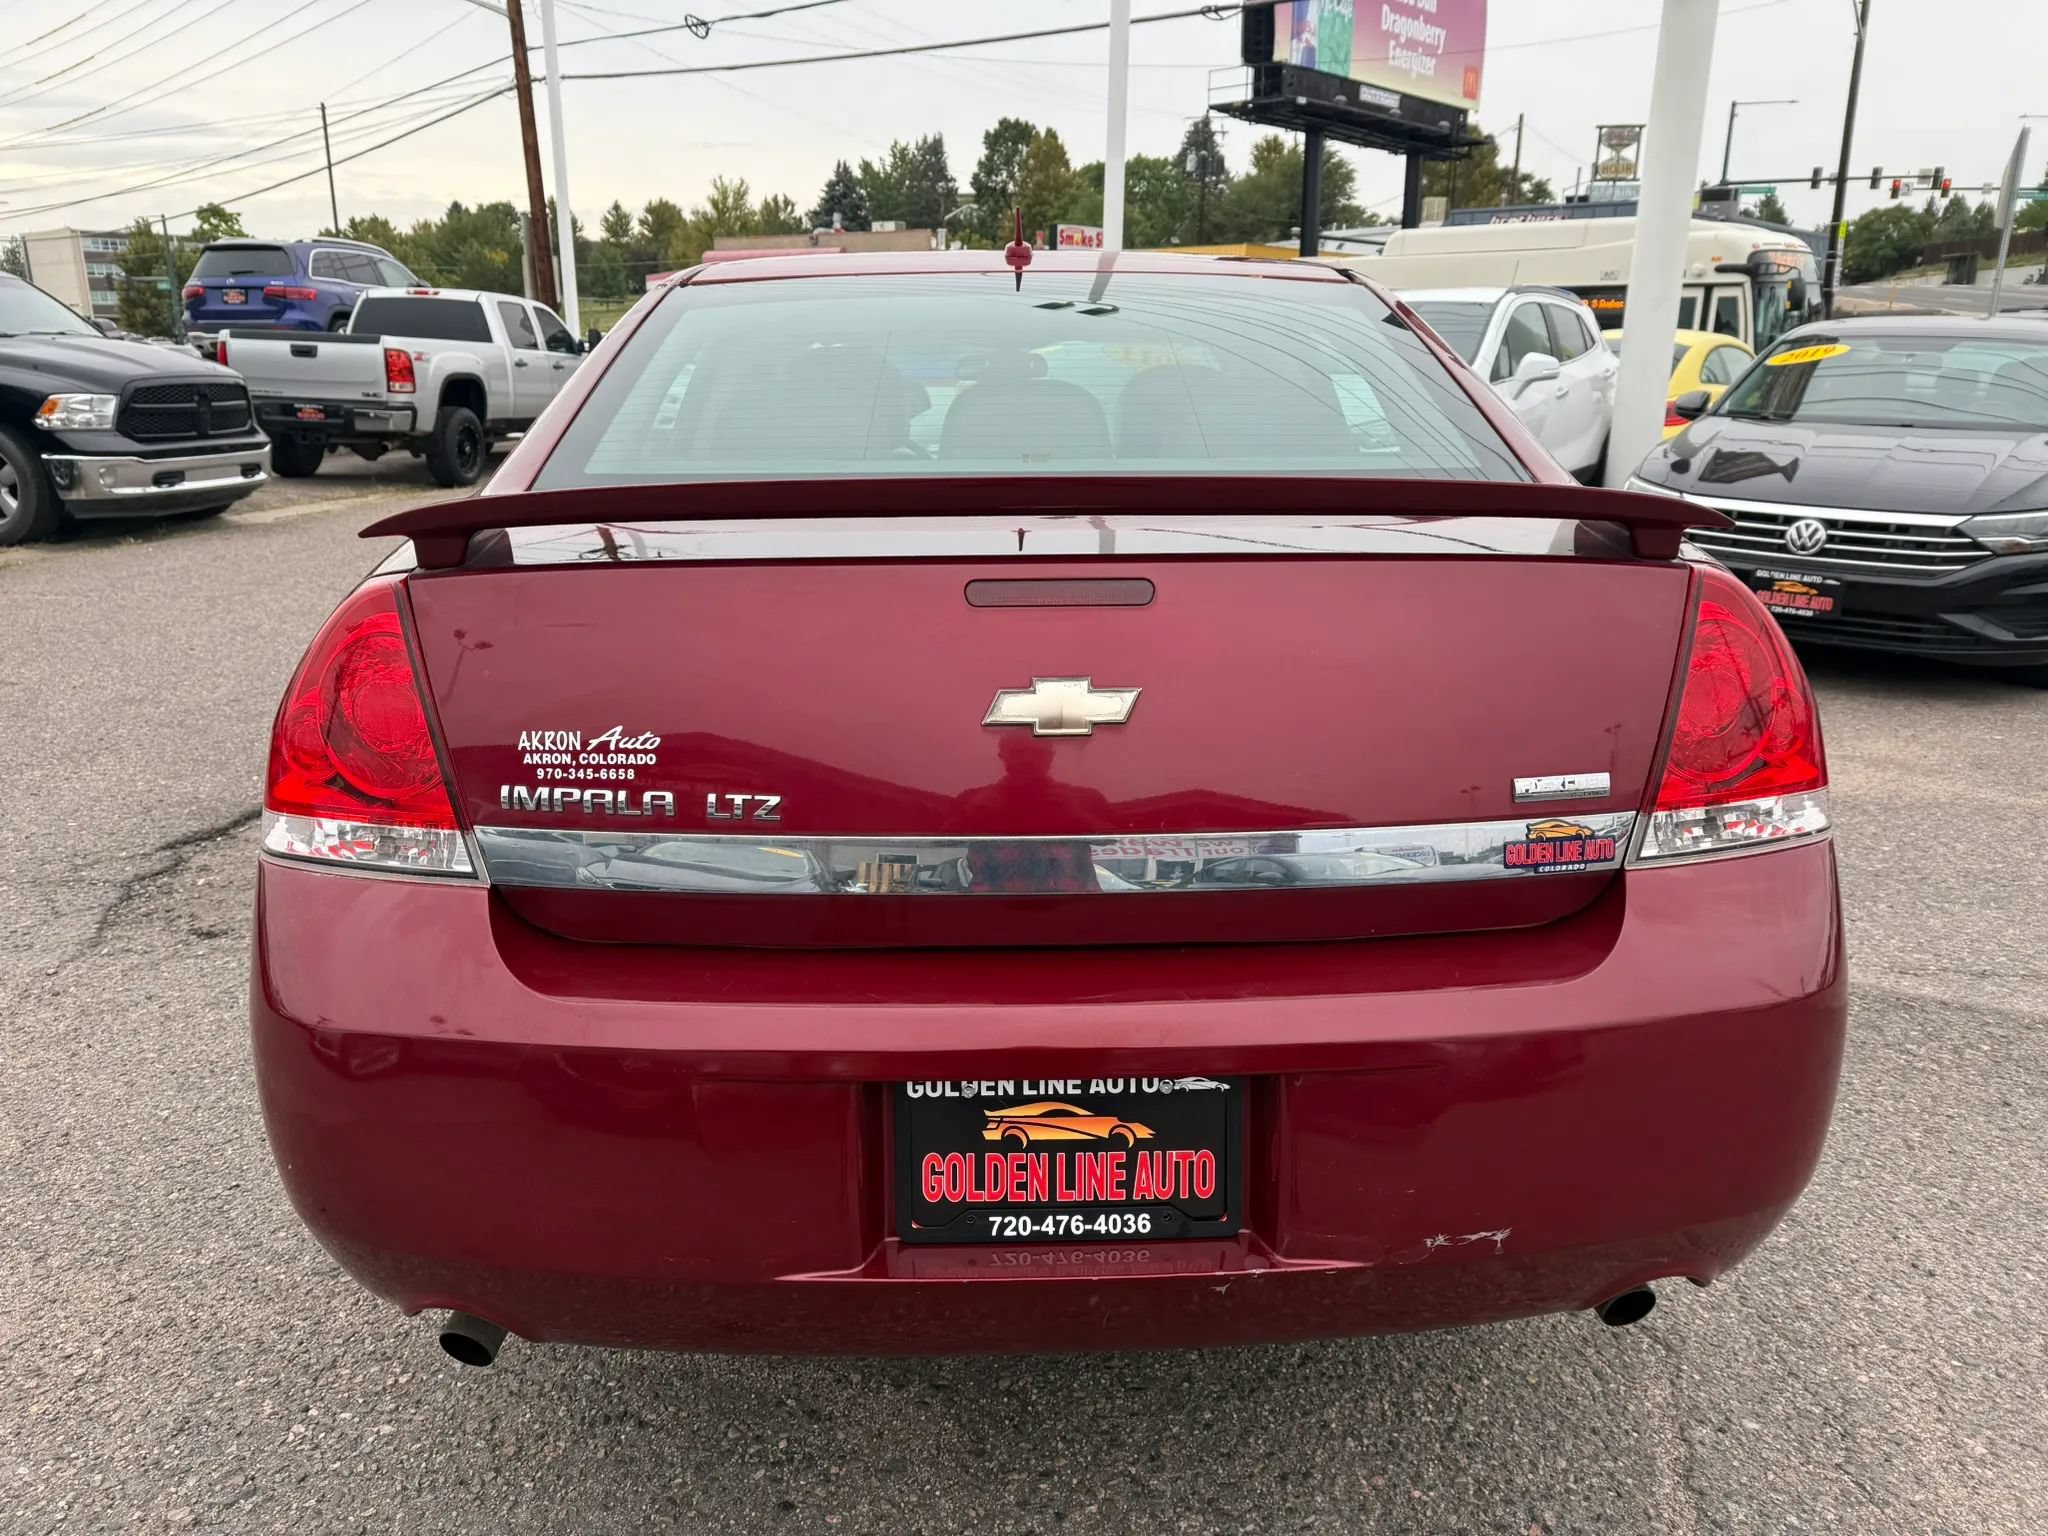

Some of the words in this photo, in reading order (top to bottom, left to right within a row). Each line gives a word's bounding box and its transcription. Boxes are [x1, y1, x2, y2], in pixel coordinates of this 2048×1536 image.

[1382, 4, 1446, 54] Dragonberry
[1389, 40, 1436, 79] Energizer
[1059, 229, 1093, 247] Smoke
[1803, 575, 1823, 583] AUTO
[1810, 595, 1834, 611] AUTO
[518, 730, 581, 751] AKRON
[587, 725, 661, 751] Auto
[523, 753, 576, 766] AKRON,
[579, 753, 656, 765] COLORADO
[536, 768, 635, 779] 970-345-6658
[500, 784, 676, 816] IMPALA
[706, 793, 782, 820] LTZ
[1506, 842, 1554, 865] GOLDEN
[1556, 840, 1582, 862] LINE
[1584, 838, 1614, 860] AUTO
[1539, 863, 1585, 872] COLORADO
[1023, 1079, 1082, 1095] LINE
[922, 1151, 1048, 1202] GOLDEN
[1056, 1151, 1126, 1201] LINE
[1133, 1149, 1216, 1200] AUTO
[988, 1213, 1151, 1236] 720-476-4036
